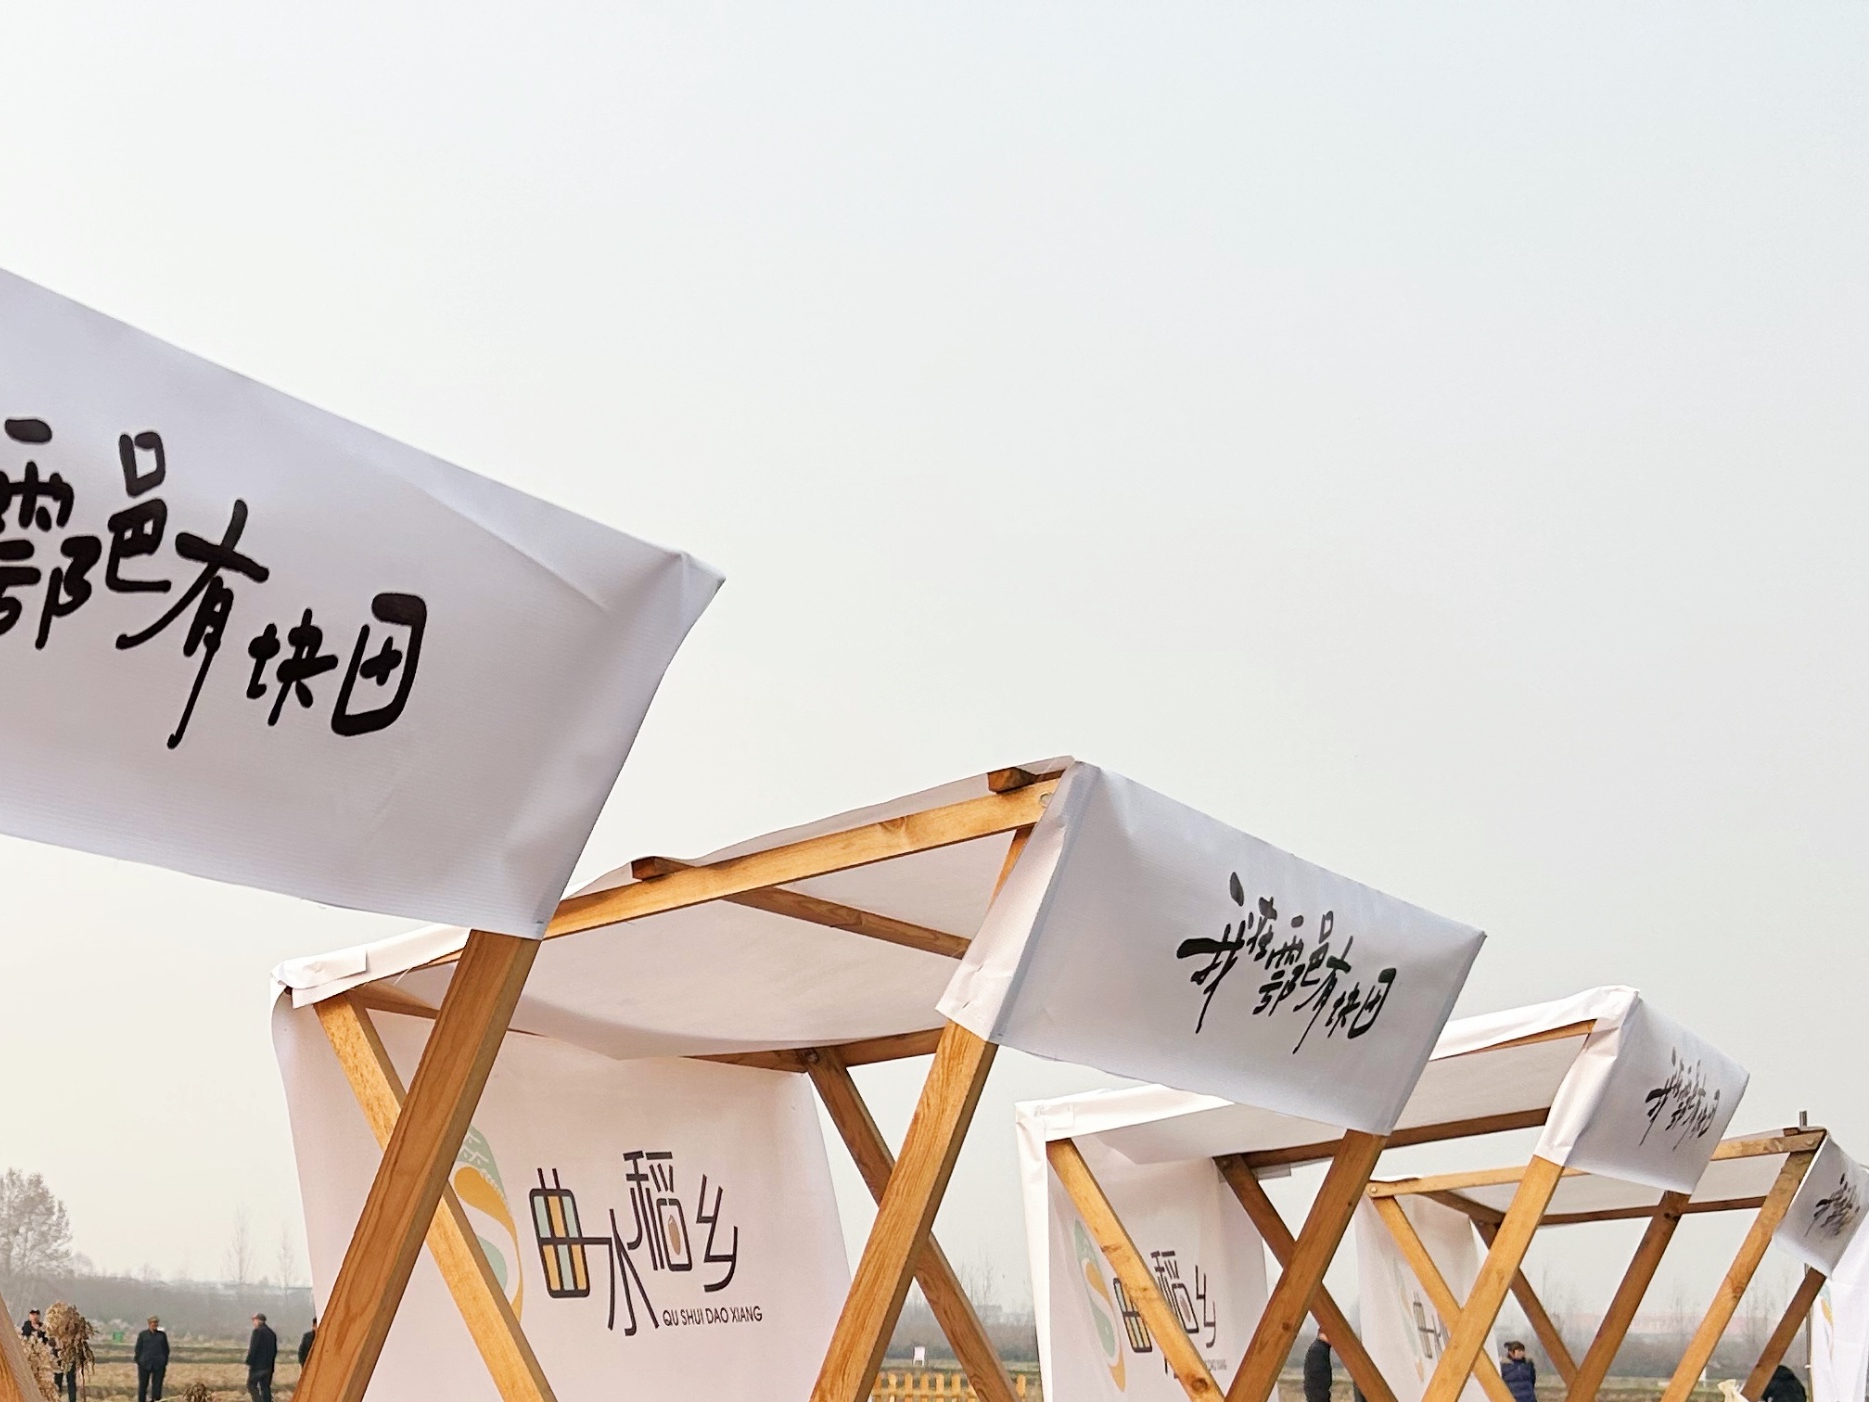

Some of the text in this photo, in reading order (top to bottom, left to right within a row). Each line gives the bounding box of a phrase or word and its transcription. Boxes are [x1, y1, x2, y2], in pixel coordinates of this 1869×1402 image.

[529, 1150, 738, 1336] 曲水稻乡
[663, 1305, 762, 1327] QU SHUI DAO XIANG
